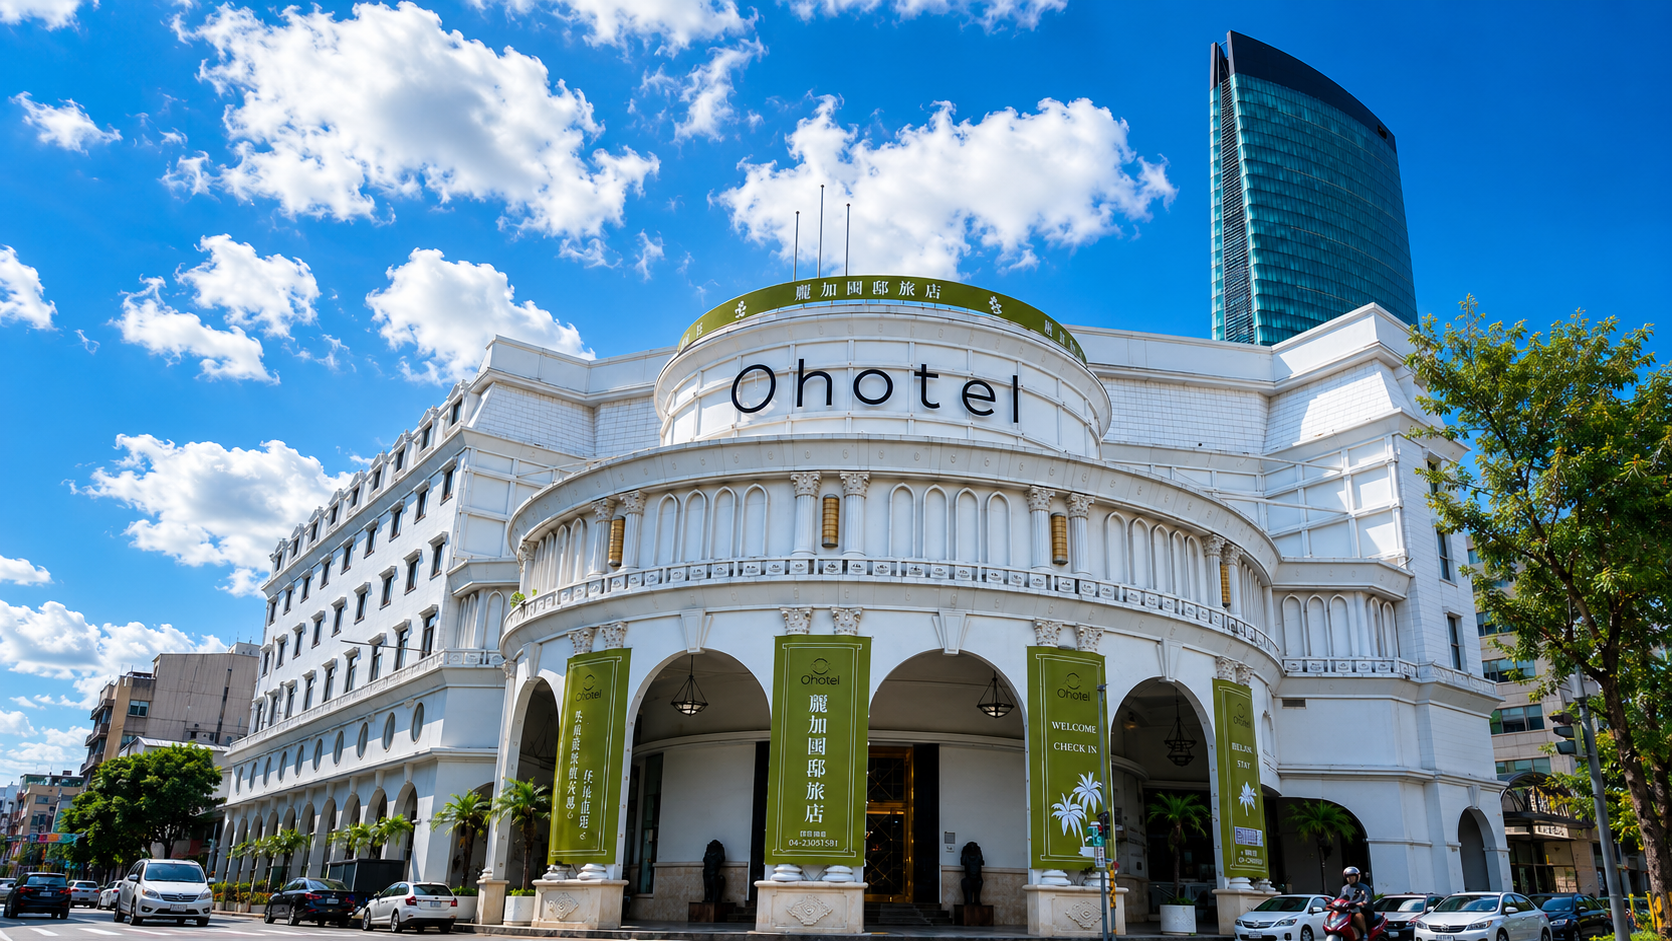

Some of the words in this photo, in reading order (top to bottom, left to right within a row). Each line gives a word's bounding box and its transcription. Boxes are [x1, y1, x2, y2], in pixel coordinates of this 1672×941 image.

[731, 359, 1020, 424] Ohotel
[800, 674, 840, 686] Ohotel
[1057, 688, 1090, 701] Ohotel
[1051, 721, 1097, 734] WELCOME
[1053, 741, 1086, 753] CHECK
[1087, 745, 1097, 754] IN
